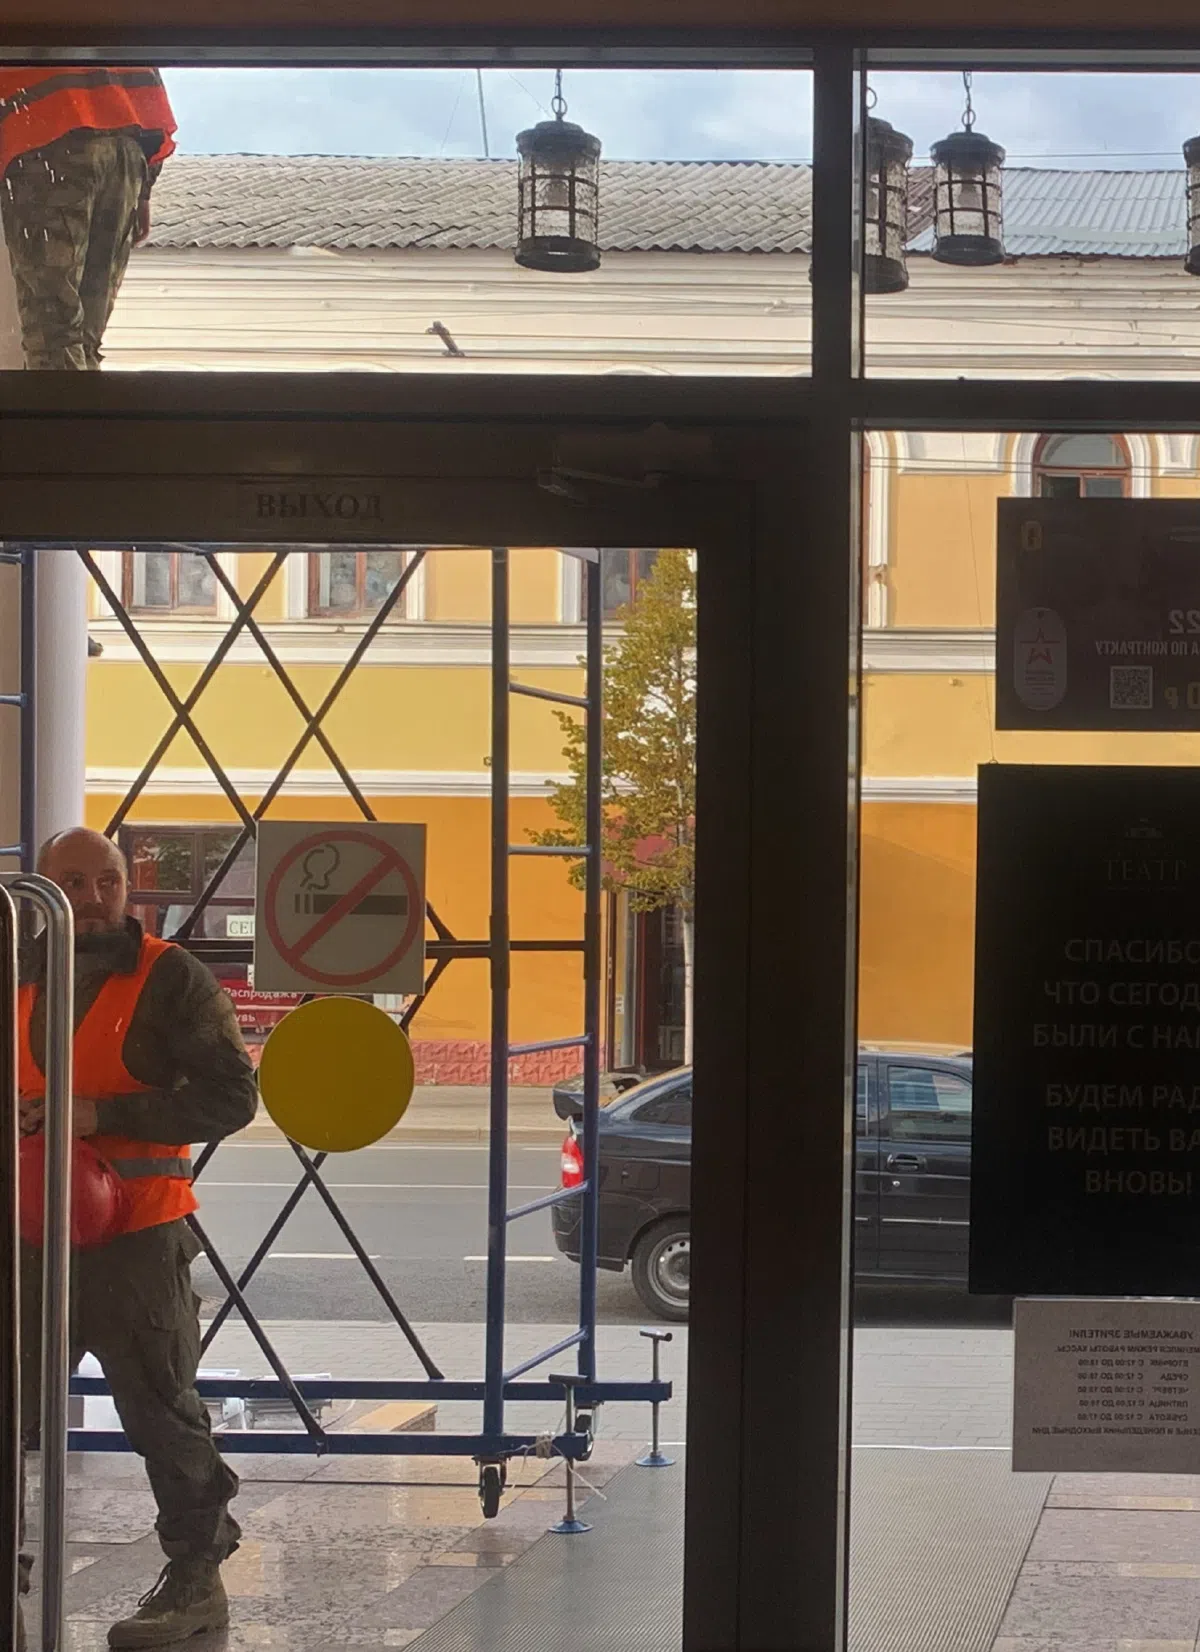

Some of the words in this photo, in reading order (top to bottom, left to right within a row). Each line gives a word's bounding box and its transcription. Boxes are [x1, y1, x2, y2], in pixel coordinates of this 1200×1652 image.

[257, 492, 384, 523] ВЫХОД
[1044, 981, 1101, 1006] ЧТО
[1034, 1024, 1118, 1049] БЫЛИ
[1127, 1024, 1145, 1049] С
[1045, 1084, 1144, 1113] БУДЕМ
[1047, 1127, 1161, 1157] ВИДЕТЬ
[1084, 1170, 1194, 1196] ВНОВЬ!
